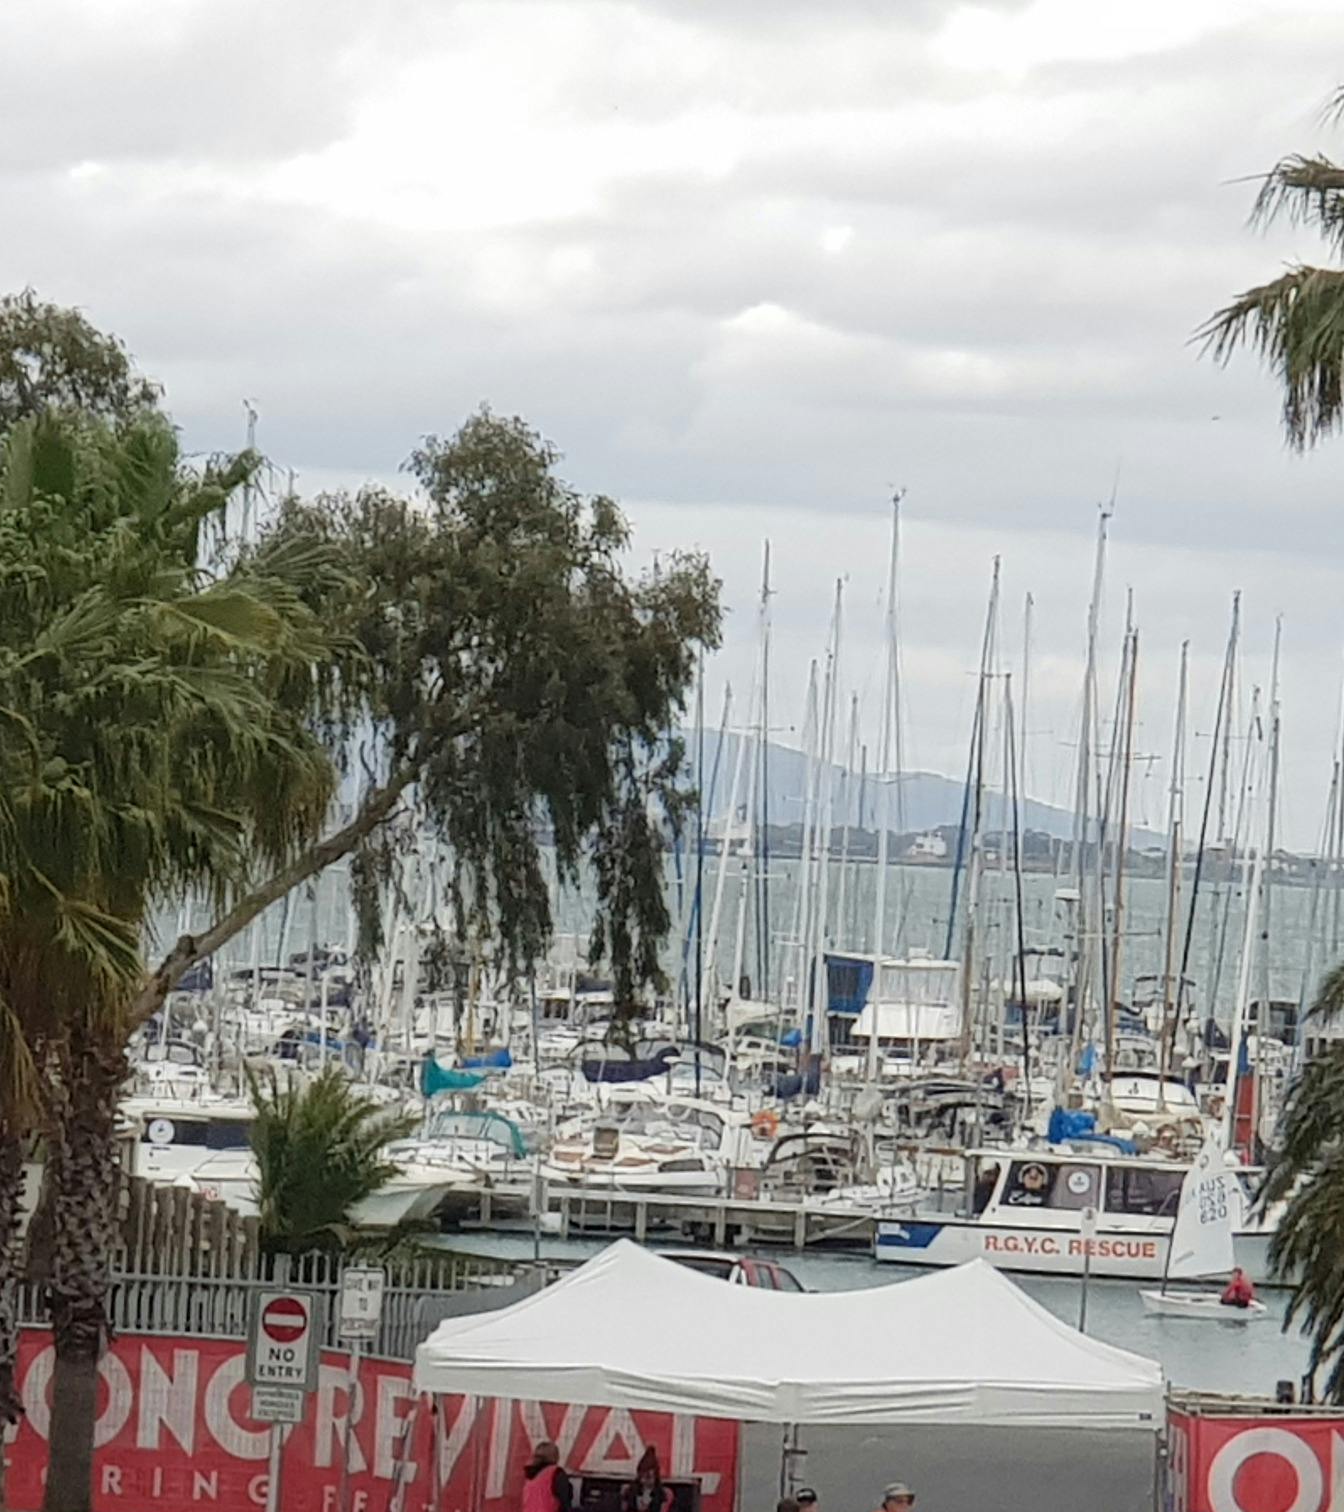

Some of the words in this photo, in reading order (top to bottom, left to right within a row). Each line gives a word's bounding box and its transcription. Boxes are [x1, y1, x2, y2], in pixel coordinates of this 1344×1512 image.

[984, 1234, 1060, 1256] R.G.Y.C.
[1068, 1239, 1156, 1259] RESCUE
[268, 1347, 296, 1363] NO
[258, 1364, 303, 1379] ENTRY
